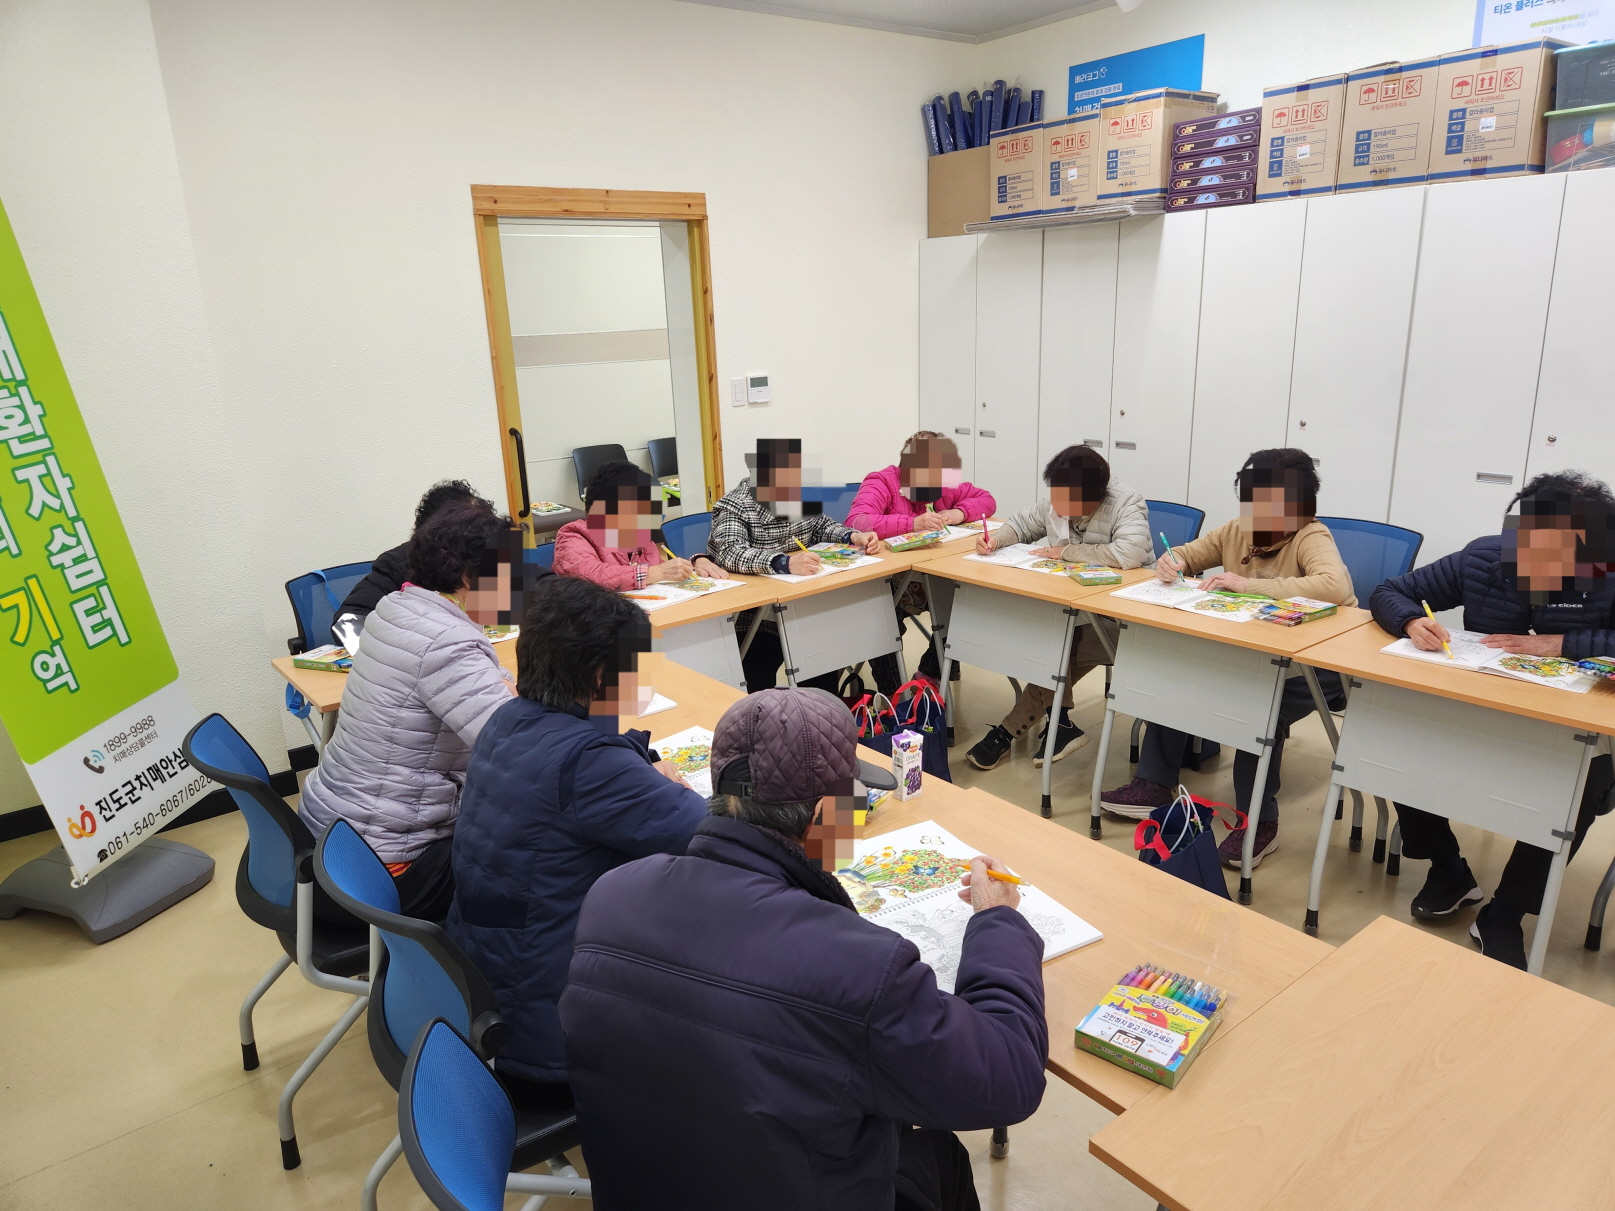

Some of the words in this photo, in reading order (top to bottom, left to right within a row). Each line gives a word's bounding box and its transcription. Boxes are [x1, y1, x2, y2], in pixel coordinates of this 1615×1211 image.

[1493, 2, 1512, 14] 티온
[103, 715, 156, 754] 1899-9988
[112, 730, 159, 764] 치매상담콜센터
[1102, 1012, 1127, 1026] 고민하지
[1126, 1022, 1141, 1031] 말고
[1140, 1027, 1174, 1044] 연락주세요!
[1116, 1034, 1138, 1046] 109
